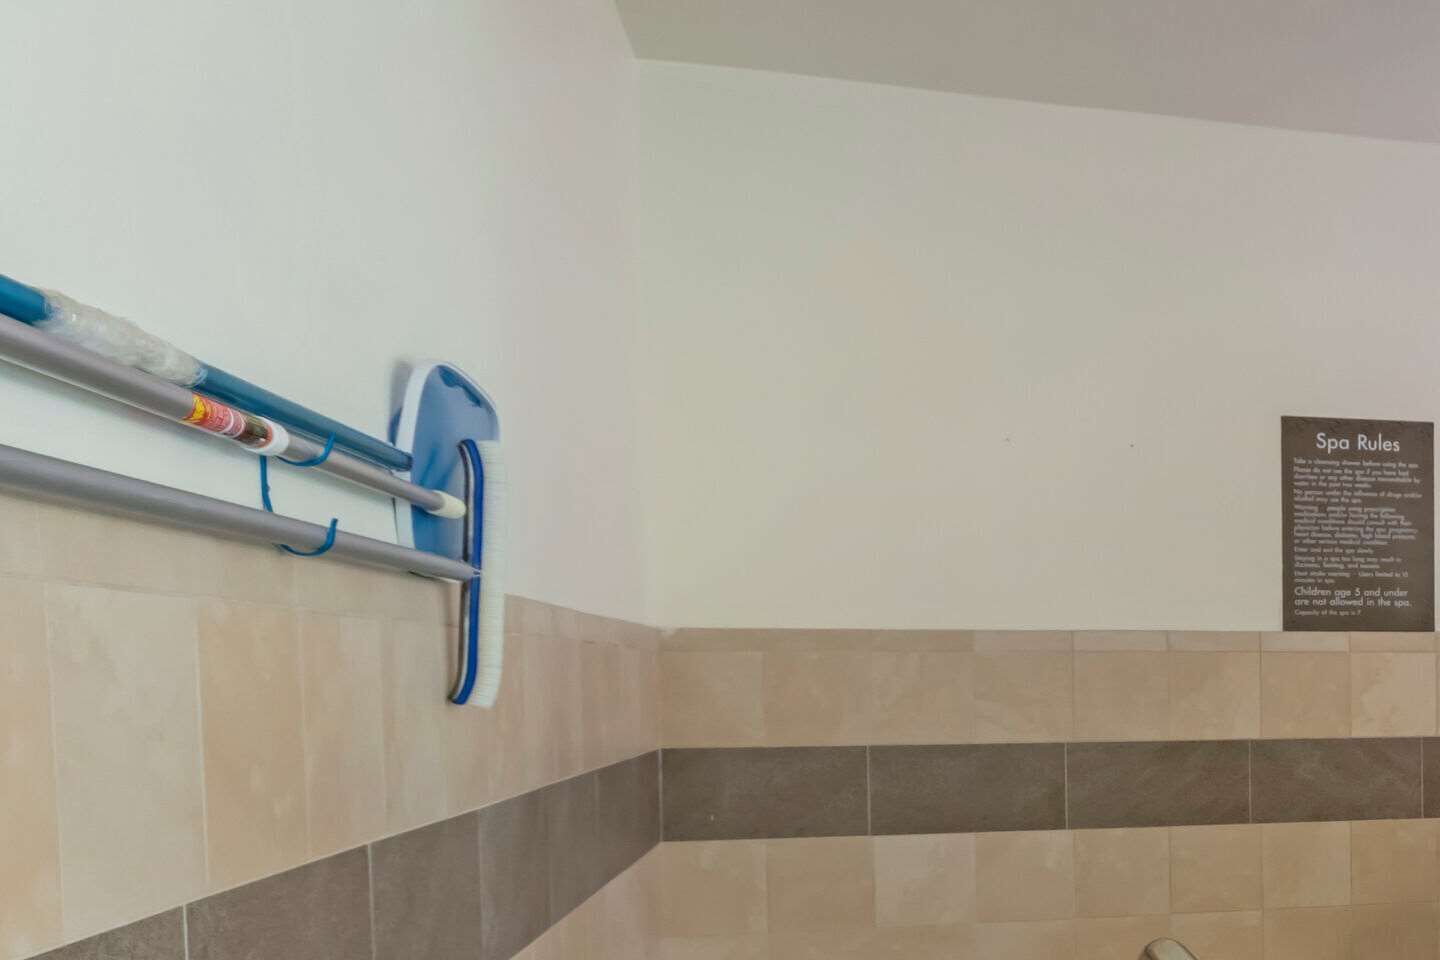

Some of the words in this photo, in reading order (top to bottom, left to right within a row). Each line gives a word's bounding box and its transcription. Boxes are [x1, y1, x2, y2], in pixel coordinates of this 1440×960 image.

[1316, 432, 1350, 454] Spa
[1357, 432, 1400, 452] Rules
[1294, 586, 1331, 596] Children
[1334, 590, 1352, 599] age
[1363, 587, 1381, 597] and
[1383, 587, 1409, 597] under
[1312, 598, 1327, 606] not
[1329, 597, 1364, 606] allowed
[1366, 597, 1375, 606] in
[1377, 597, 1391, 607] the
